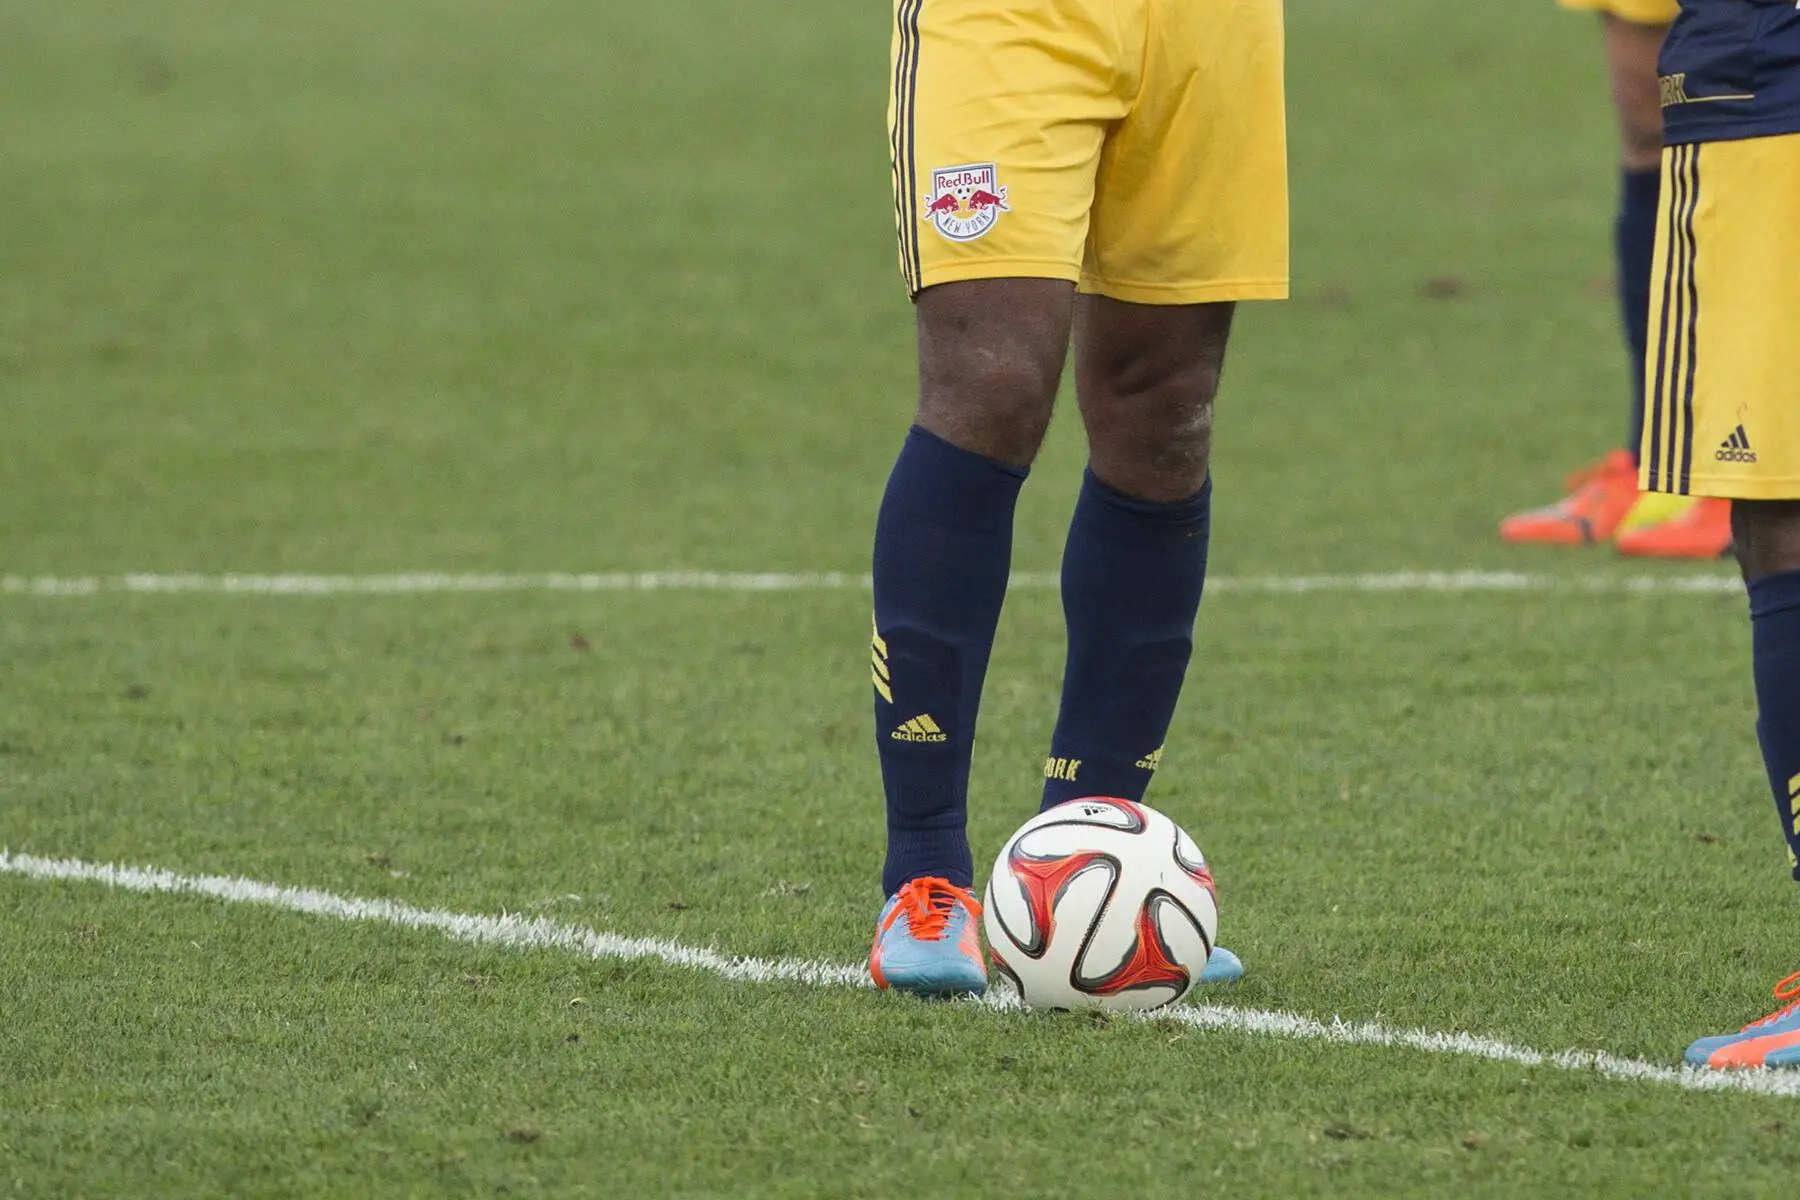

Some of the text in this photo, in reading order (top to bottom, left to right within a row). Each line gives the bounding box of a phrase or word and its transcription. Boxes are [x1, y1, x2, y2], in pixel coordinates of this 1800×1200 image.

[937, 170, 990, 189] Red Bull
[891, 730, 947, 742] adidas
[1044, 756, 1082, 782] ORK
